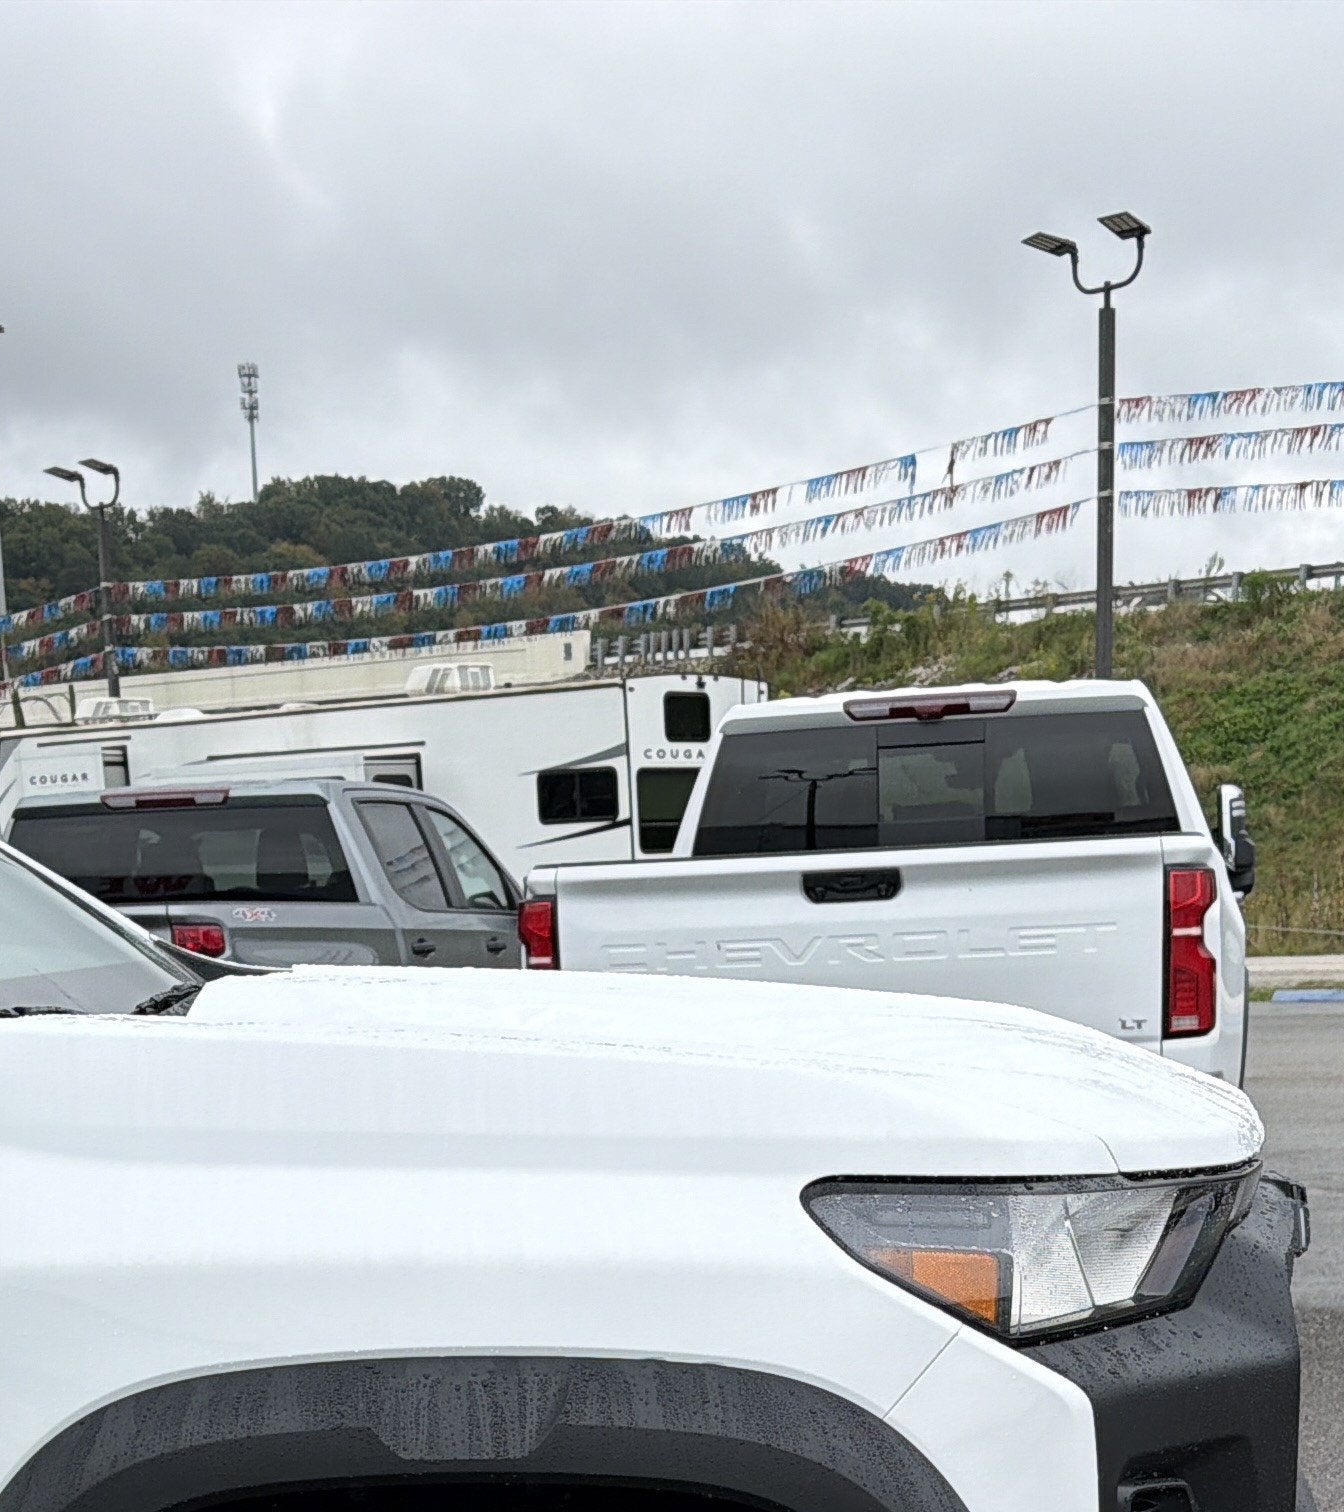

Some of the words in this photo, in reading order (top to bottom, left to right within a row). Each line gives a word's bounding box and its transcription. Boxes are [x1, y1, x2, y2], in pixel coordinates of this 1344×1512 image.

[29, 772, 89, 786] COUGAR
[600, 921, 1117, 972] CHEVROLET
[1119, 1018, 1148, 1030] LT
